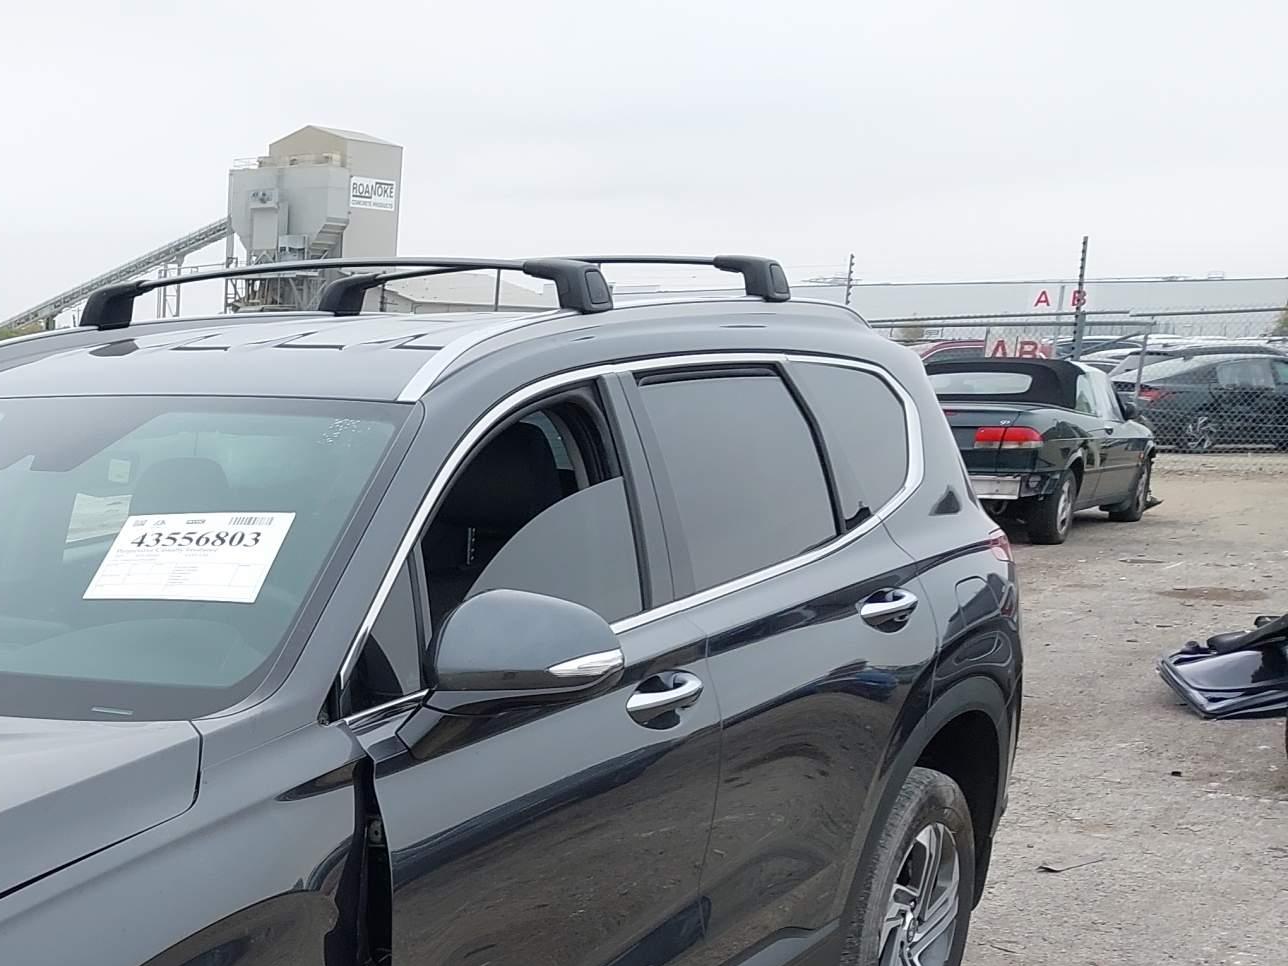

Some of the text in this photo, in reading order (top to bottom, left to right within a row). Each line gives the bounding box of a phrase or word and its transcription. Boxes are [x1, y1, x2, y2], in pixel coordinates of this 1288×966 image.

[352, 181, 394, 198] ROANOKE
[1034, 290, 1087, 307] A B
[130, 531, 261, 548] 43556803
